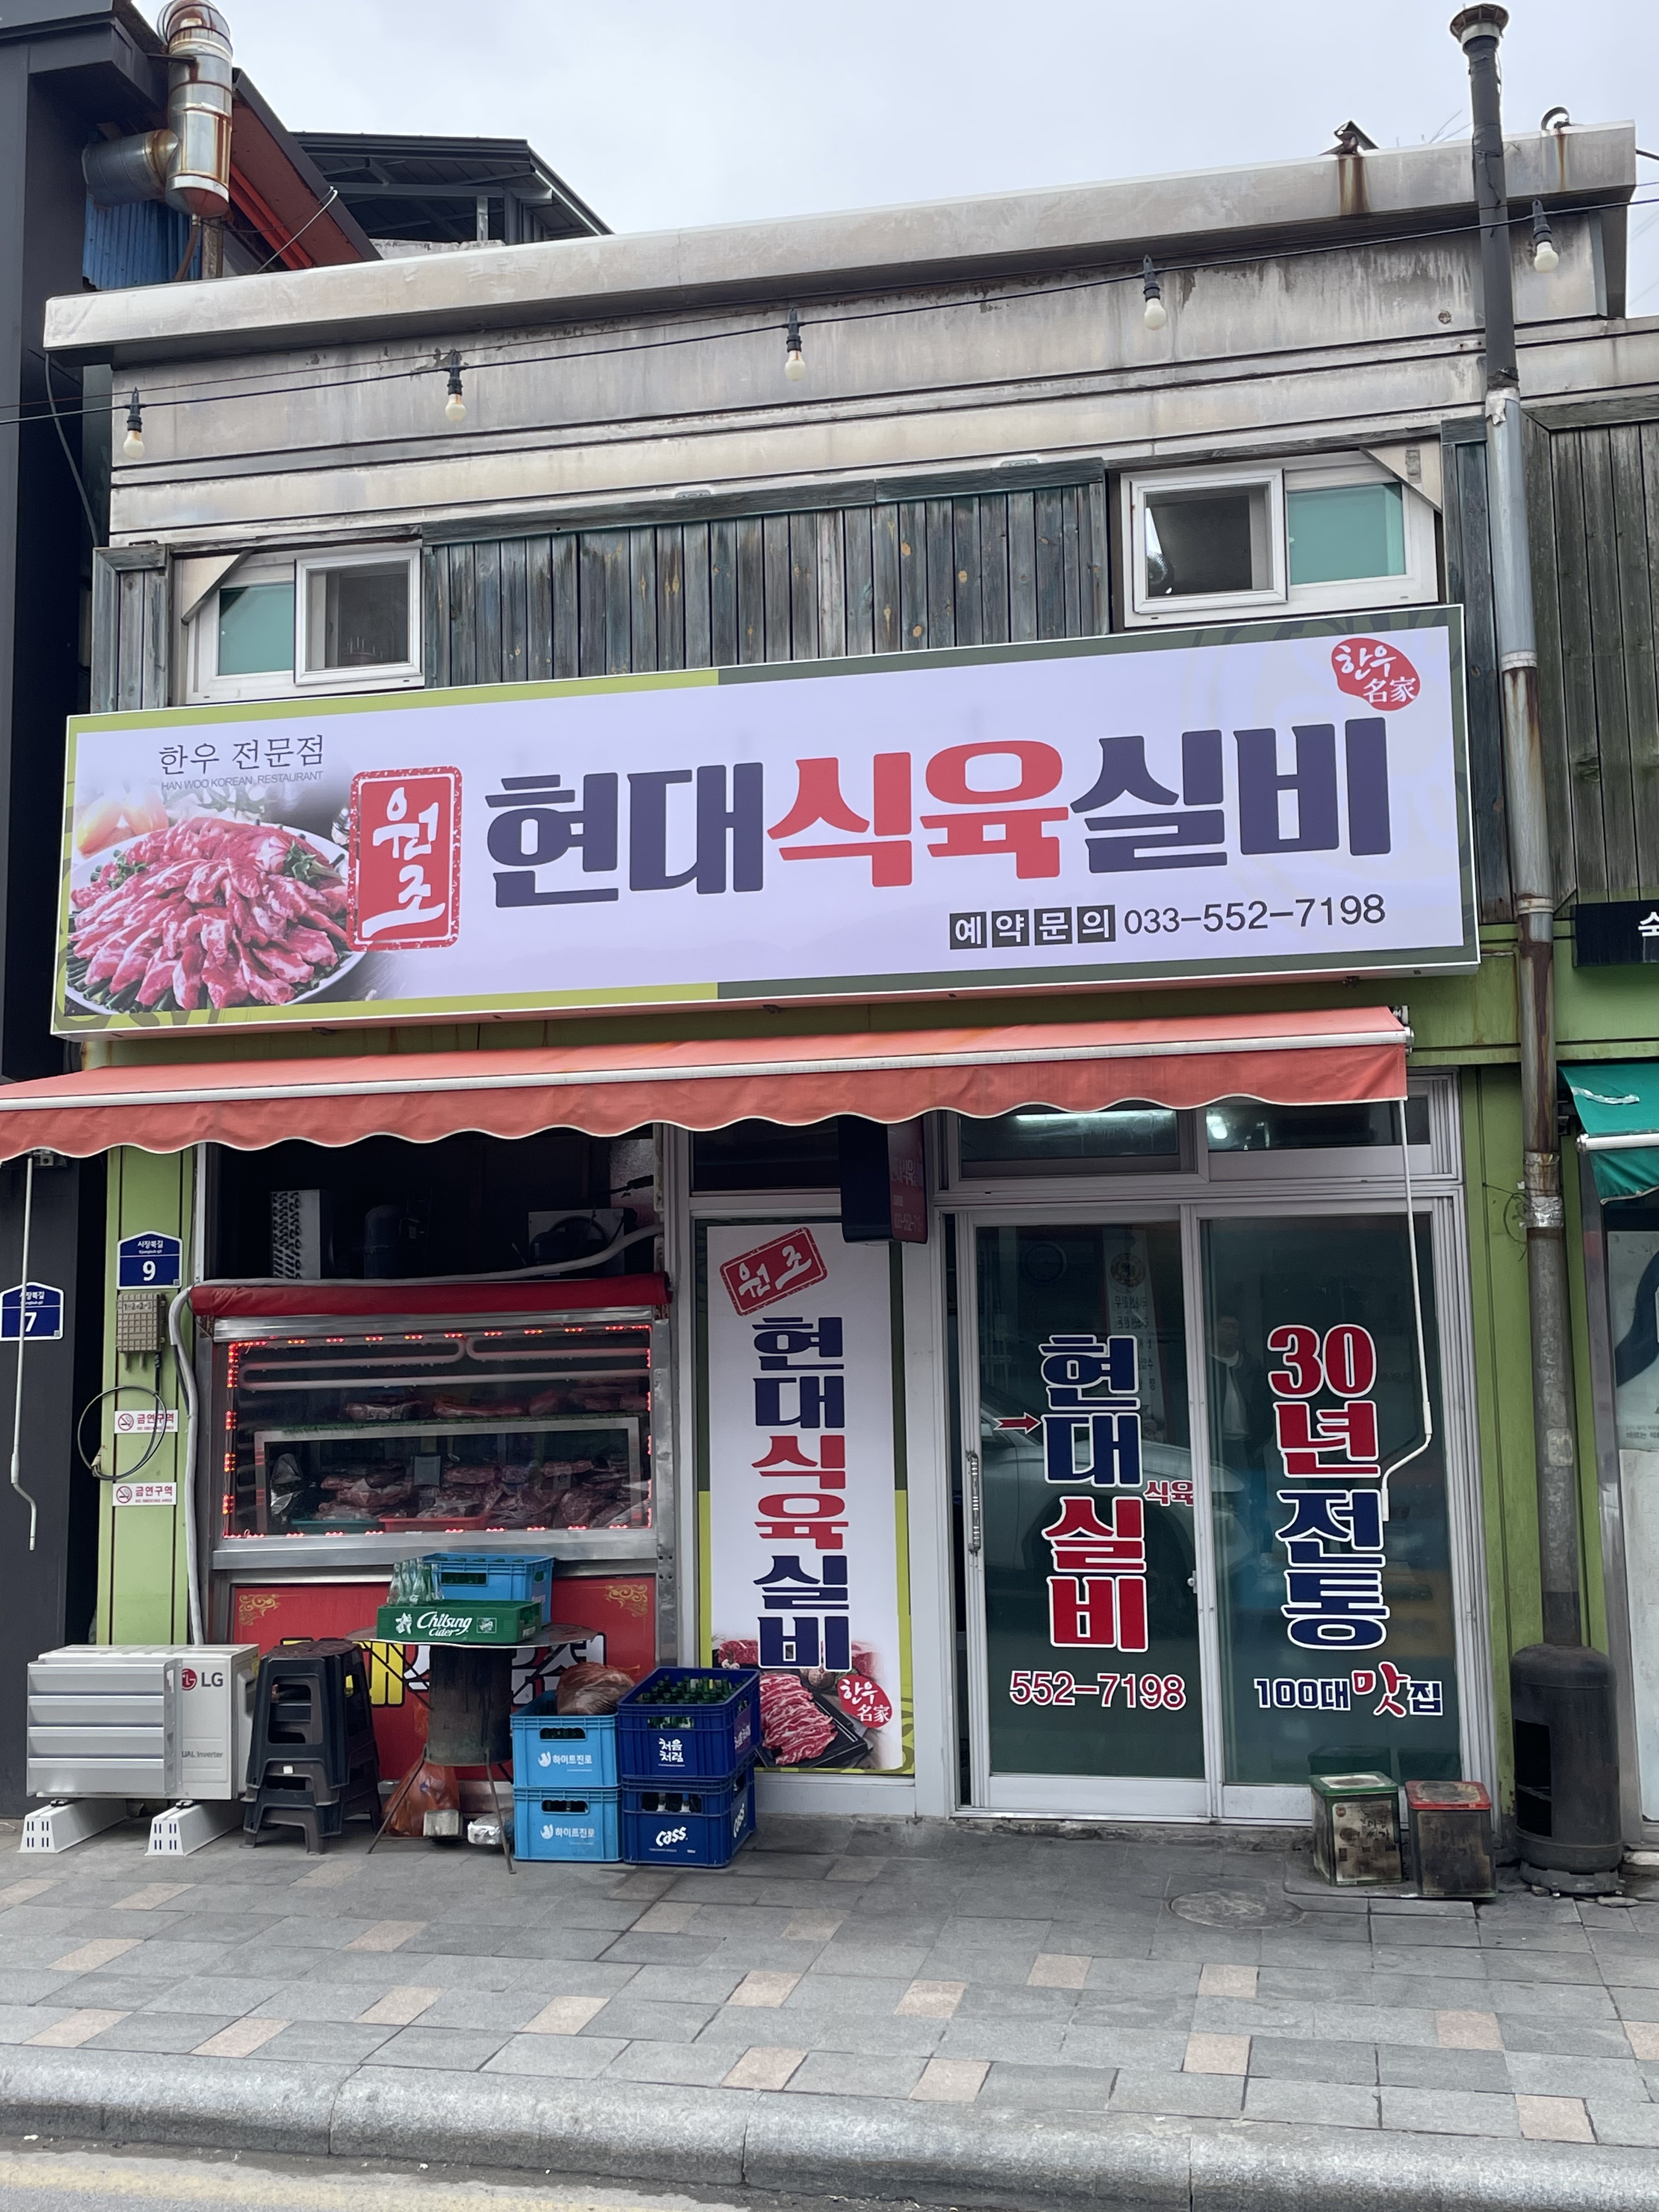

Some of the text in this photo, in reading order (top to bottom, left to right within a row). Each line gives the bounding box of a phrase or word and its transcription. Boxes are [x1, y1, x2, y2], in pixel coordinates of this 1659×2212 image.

[1335, 645, 1397, 681] 한우
[1363, 676, 1417, 703] 名家
[159, 734, 324, 775] 한우 전문점
[161, 770, 324, 791] HAN WOO KOREAN RESTAURANT
[484, 716, 1391, 909] 현대식육실비
[360, 786, 445, 939] 원조
[953, 894, 1386, 947] 예약문의 033-552-7198
[143, 1261, 156, 1282] 9
[738, 1244, 812, 1299] 원조
[24, 1312, 37, 1332] 7
[137, 1413, 174, 1425] 금연구역
[135, 1486, 173, 1497] 금연구역
[752, 1316, 852, 1672] 현대식육실비
[1143, 1480, 1193, 1507] 식육
[416, 1611, 473, 1635] Chilsung
[428, 1628, 455, 1638] Cider
[201, 1672, 224, 1688] LG
[1008, 1669, 1187, 1711] 552-7198
[839, 1678, 879, 1706] 한우
[857, 1703, 892, 1723] 名家
[658, 1737, 683, 1751] 처음
[552, 1754, 593, 1766] 하이트진로
[659, 1750, 684, 1763] 처럼
[555, 1826, 596, 1839] 하이트진로
